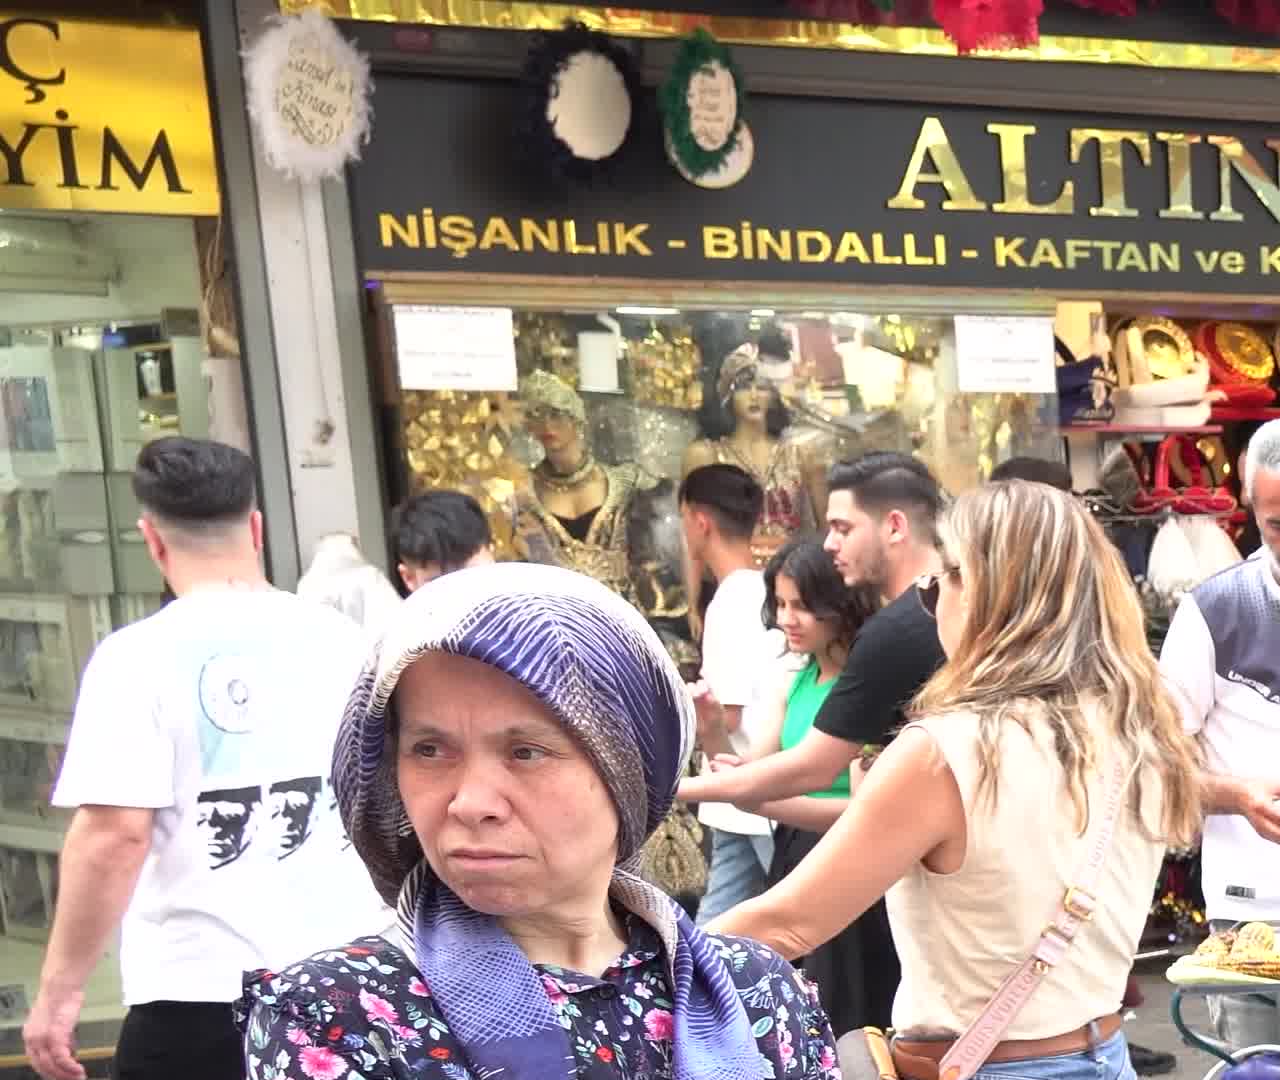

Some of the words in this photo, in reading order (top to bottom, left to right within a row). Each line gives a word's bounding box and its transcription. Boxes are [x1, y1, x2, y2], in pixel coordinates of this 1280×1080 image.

[378, 208, 654, 258] NİŞANLIK
[702, 222, 947, 266] BİNDALLI
[993, 236, 1181, 274] KAFTAN
[1195, 249, 1246, 275] ve
